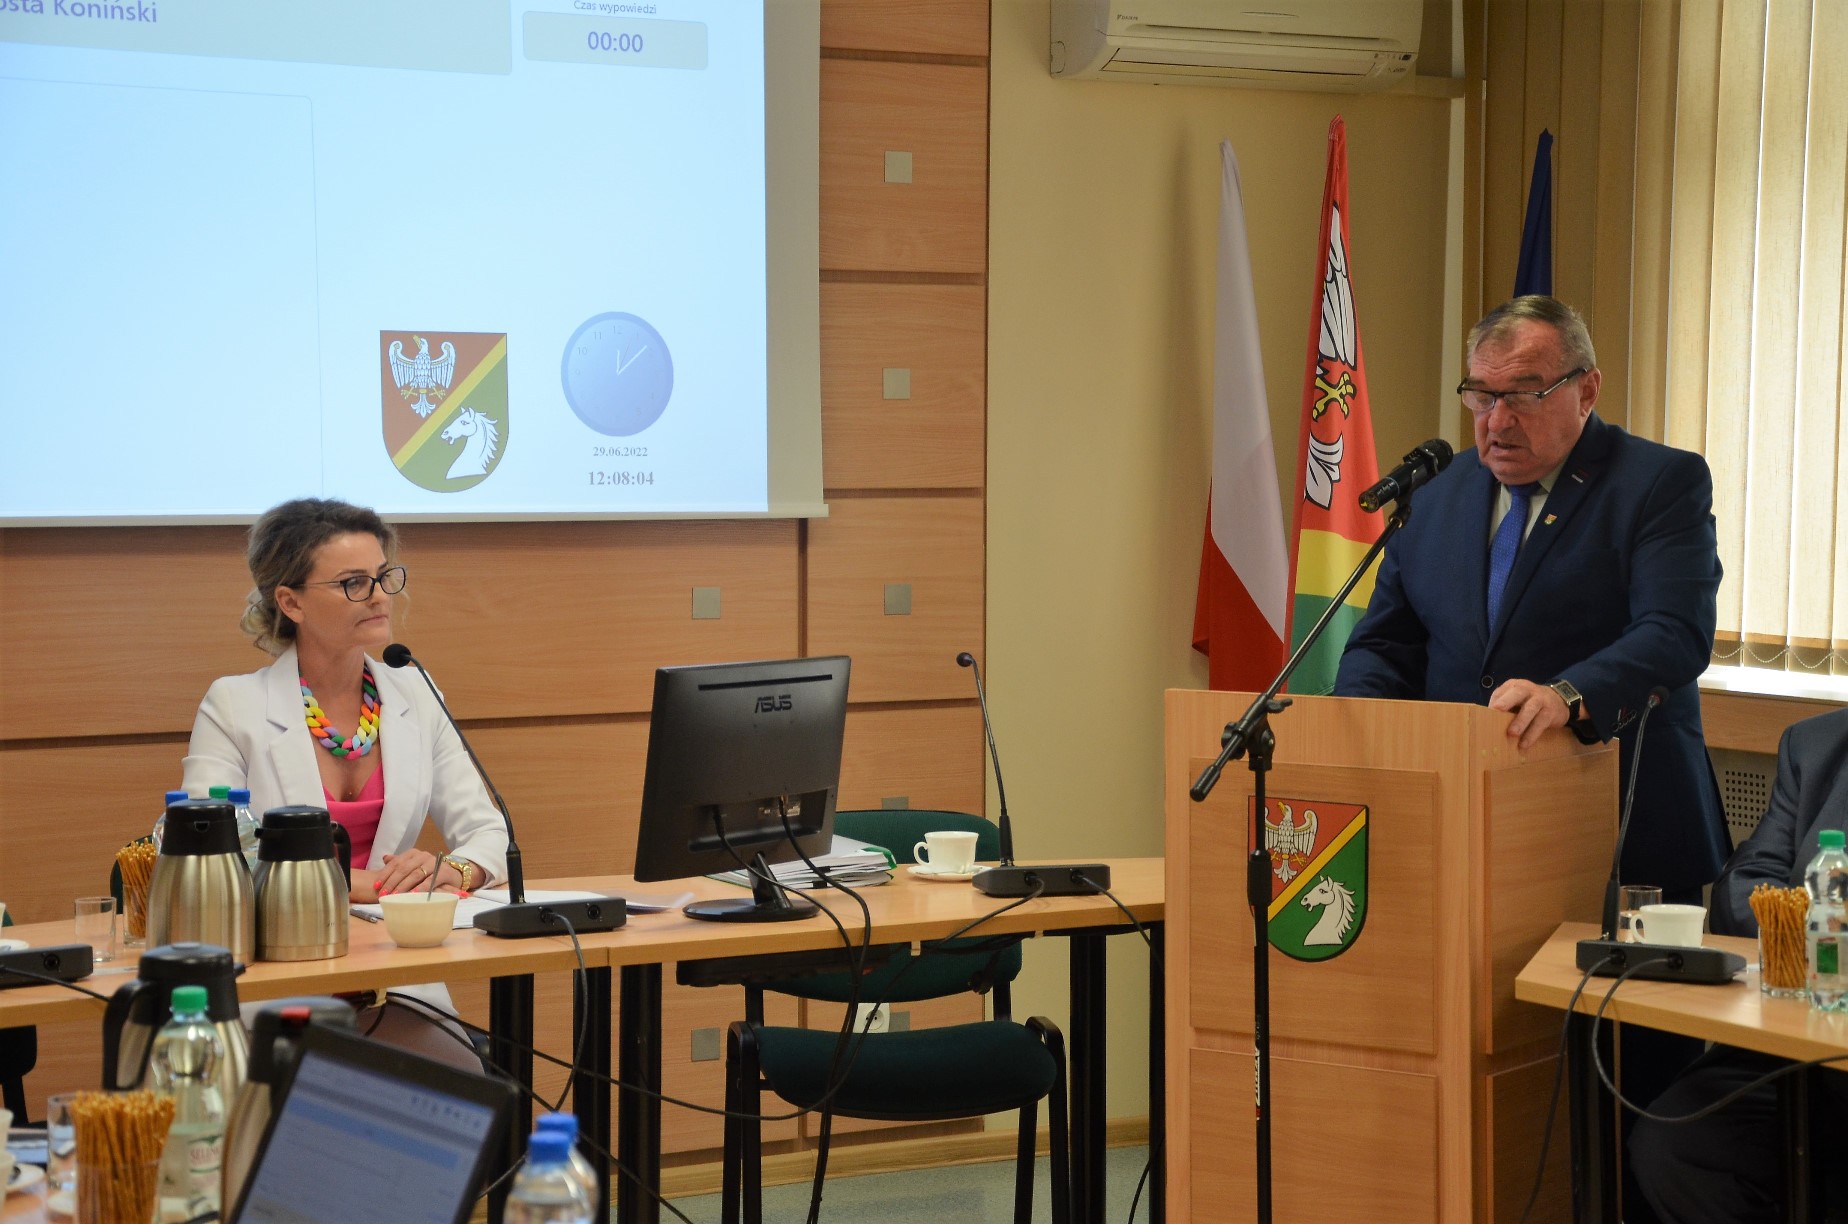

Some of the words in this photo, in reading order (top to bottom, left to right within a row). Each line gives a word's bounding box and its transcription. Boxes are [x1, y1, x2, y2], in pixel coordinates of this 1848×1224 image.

[54, 0, 157, 22] Koniński
[573, 0, 597, 11] Czas
[599, 2, 657, 15] wypowiedzi
[587, 31, 644, 53] 00:00
[593, 446, 648, 457] 29.06.2022
[588, 471, 655, 486] 12:08:04
[754, 694, 793, 714] ASUS
